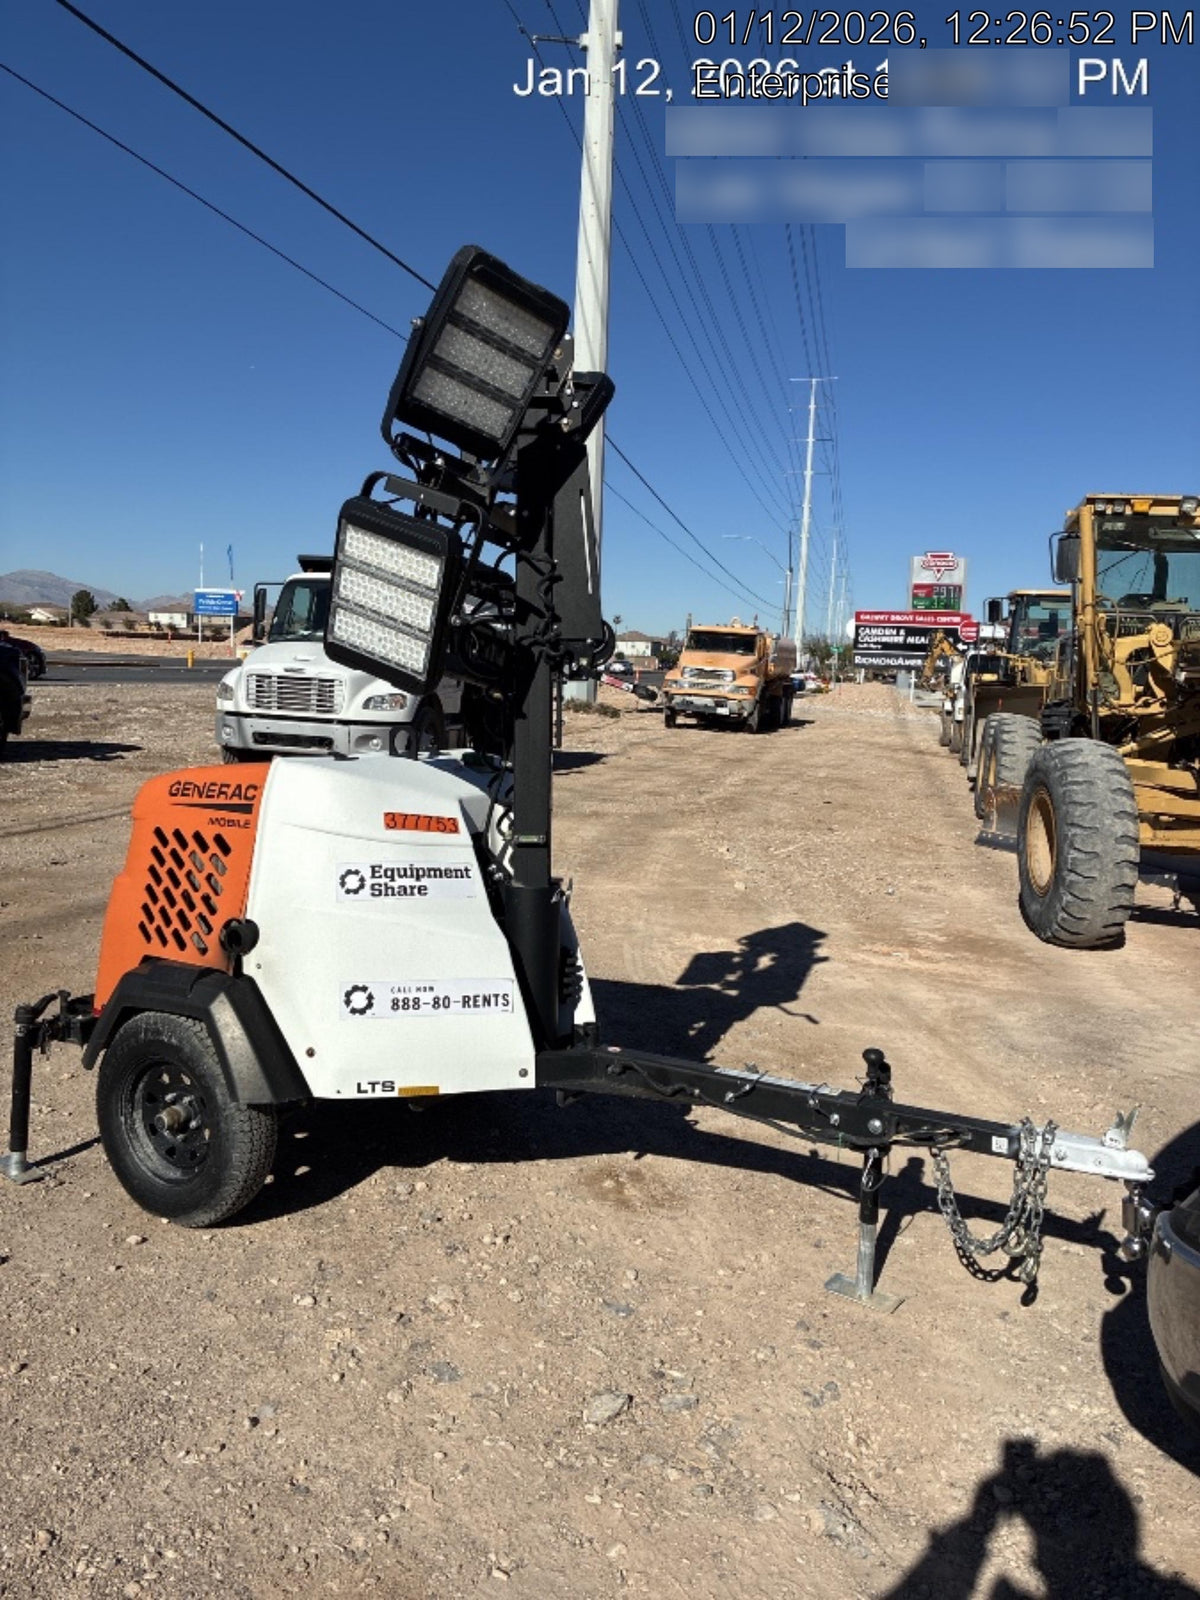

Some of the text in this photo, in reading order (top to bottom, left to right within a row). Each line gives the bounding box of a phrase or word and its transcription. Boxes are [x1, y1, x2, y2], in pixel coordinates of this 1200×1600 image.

[168, 780, 259, 802] GENERAC
[207, 817, 251, 829] MOBILE
[384, 812, 459, 834] 377753
[370, 863, 471, 882] Equipment
[370, 882, 428, 897] Share
[390, 986, 412, 994] CALL
[390, 993, 510, 1011] 888-80-RENTS
[356, 1080, 395, 1094] LTS
